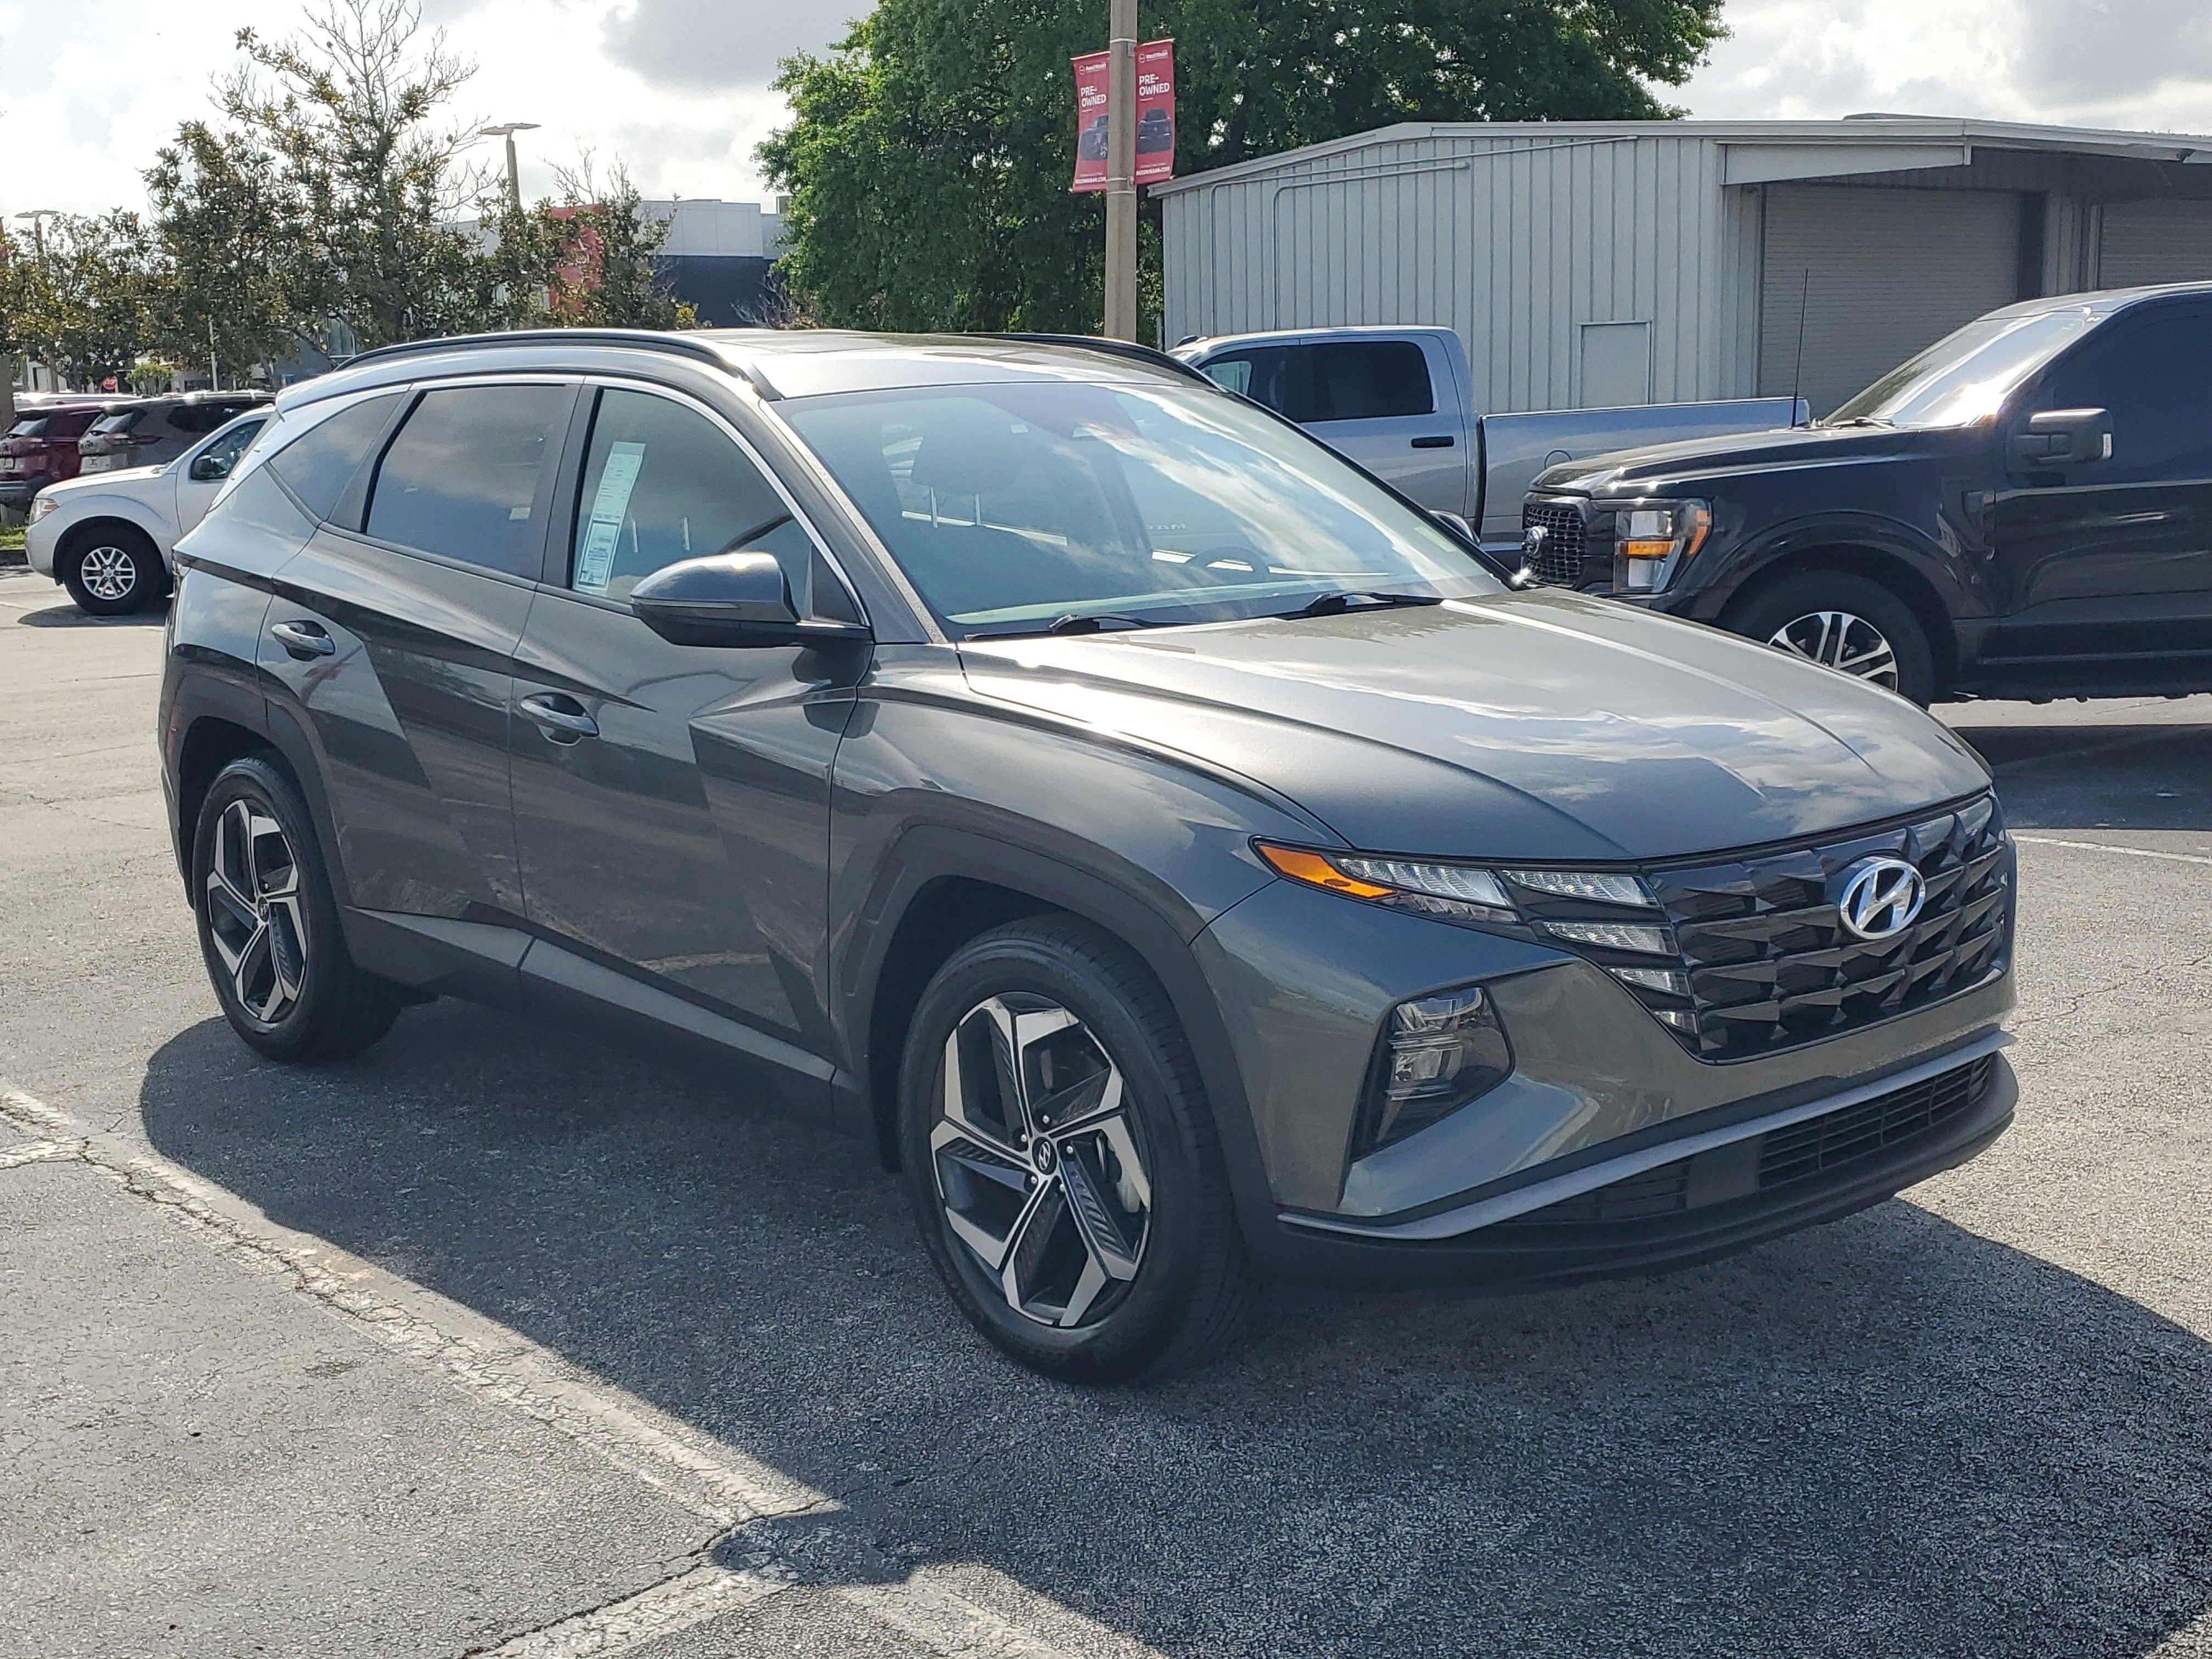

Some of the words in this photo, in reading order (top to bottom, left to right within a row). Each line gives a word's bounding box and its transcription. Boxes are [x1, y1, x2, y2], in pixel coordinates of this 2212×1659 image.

[1139, 74, 1160, 86] PRE-
[1081, 86, 1098, 97] PRE-
[1139, 82, 1170, 96] OWNED
[1081, 94, 1107, 108] OWNED
